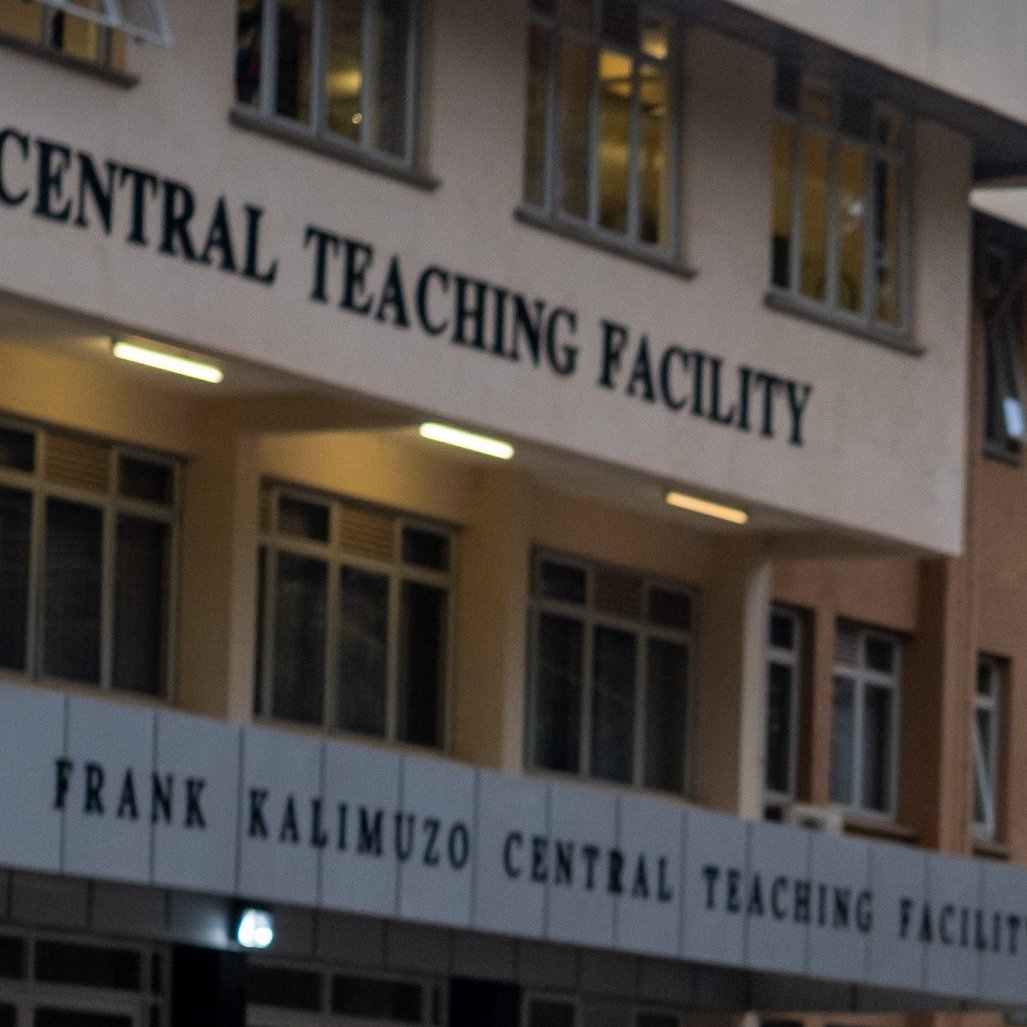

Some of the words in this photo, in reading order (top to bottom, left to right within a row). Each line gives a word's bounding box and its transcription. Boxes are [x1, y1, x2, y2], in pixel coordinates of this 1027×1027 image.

[0, 128, 278, 285] CENTRAL
[304, 226, 580, 377] TEACHING
[599, 319, 812, 446] FACILITY
[54, 757, 207, 829] FRANK
[247, 788, 471, 870] KALIMUZO
[504, 832, 673, 903] CENTRAL
[703, 866, 874, 934] TEACHING
